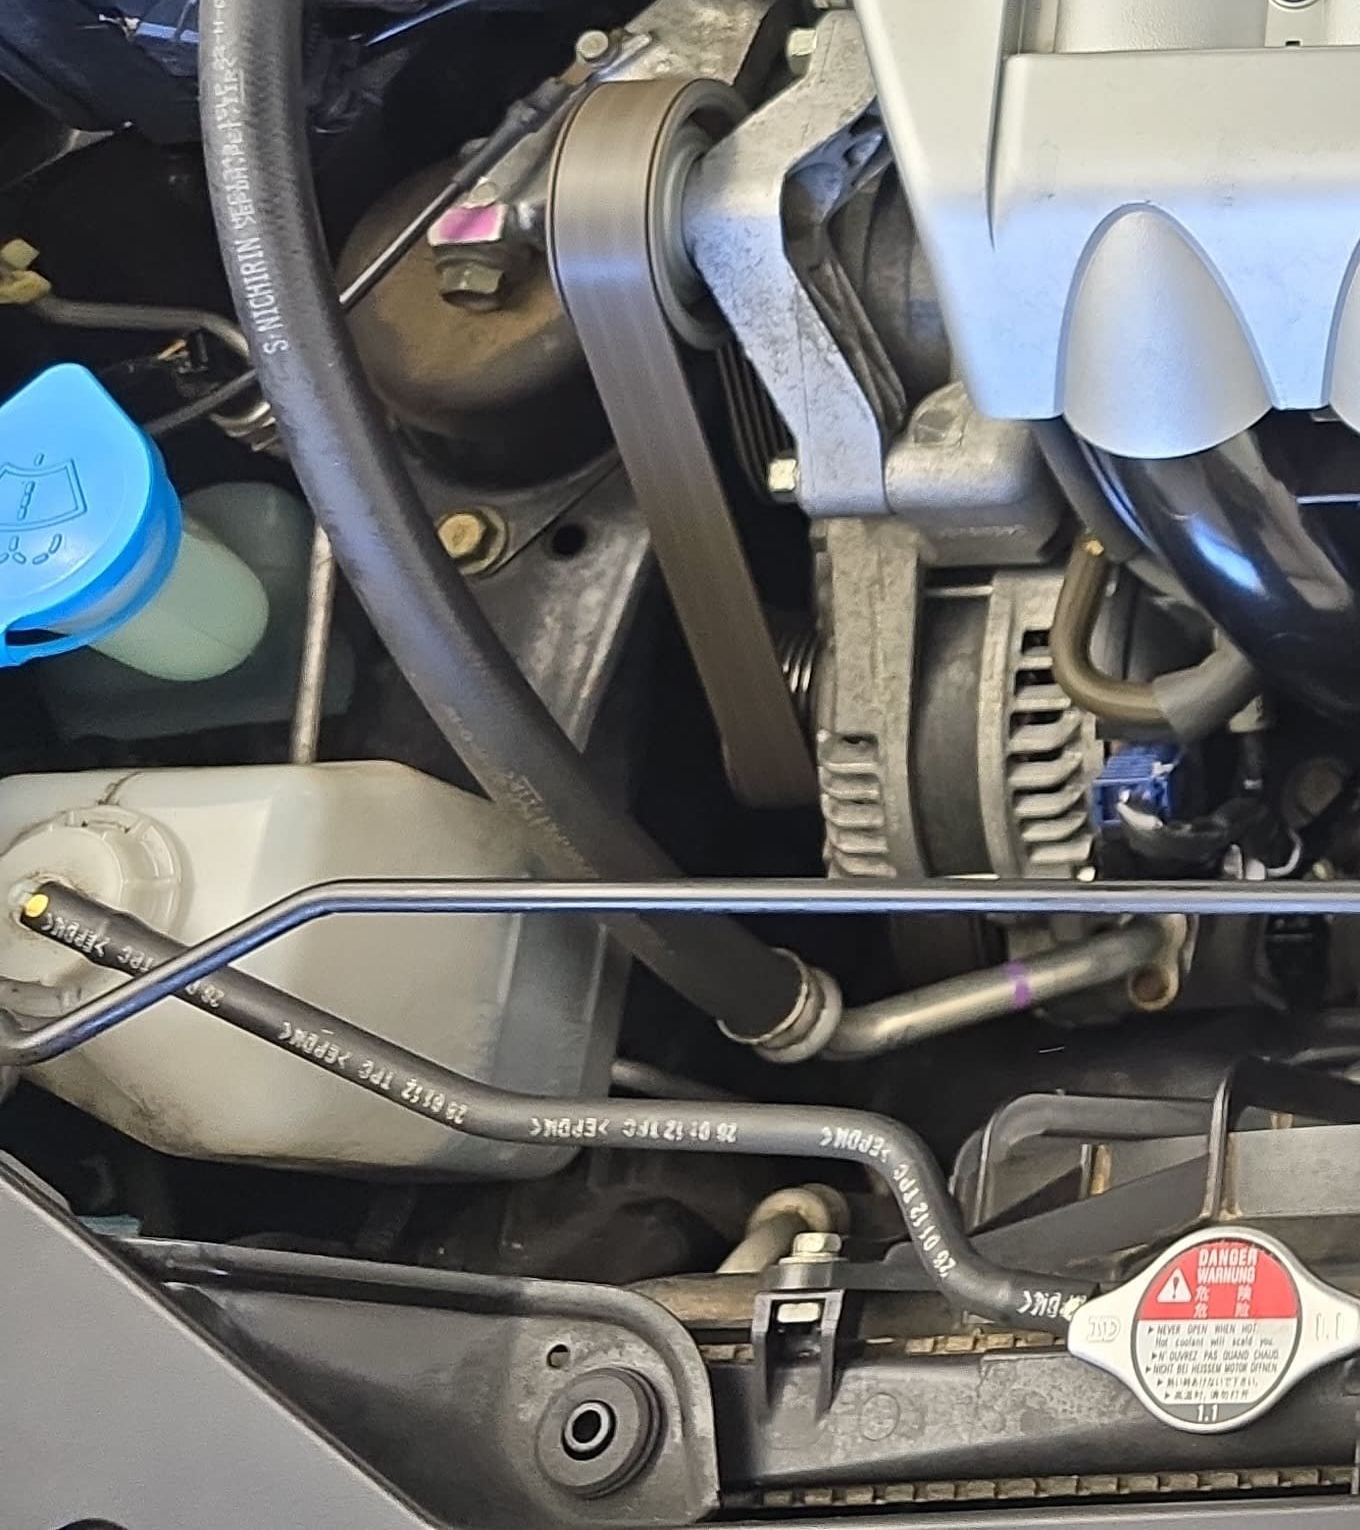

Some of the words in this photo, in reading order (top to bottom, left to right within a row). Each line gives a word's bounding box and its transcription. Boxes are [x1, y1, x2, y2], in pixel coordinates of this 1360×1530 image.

[1198, 1248, 1258, 1267] DANGER
[1196, 1267, 1256, 1283] WARNUNG
[1156, 1324, 1181, 1335] NEVER
[1187, 1324, 1208, 1335] OPEN
[1214, 1323, 1236, 1335] WHEN
[1175, 1337, 1204, 1348] coolant
[1210, 1337, 1225, 1348] will
[1168, 1350, 1199, 1362] OUVREZ
[1203, 1349, 1219, 1361] PAS
[1222, 1349, 1250, 1361] QUAND
[1153, 1363, 1175, 1375] NICHT
[1176, 1363, 1189, 1375] BEI
[1190, 1363, 1223, 1374] HEISSEM
[1223, 1363, 1248, 1374] MOTOR
[1197, 1403, 1219, 1423] 1.1
